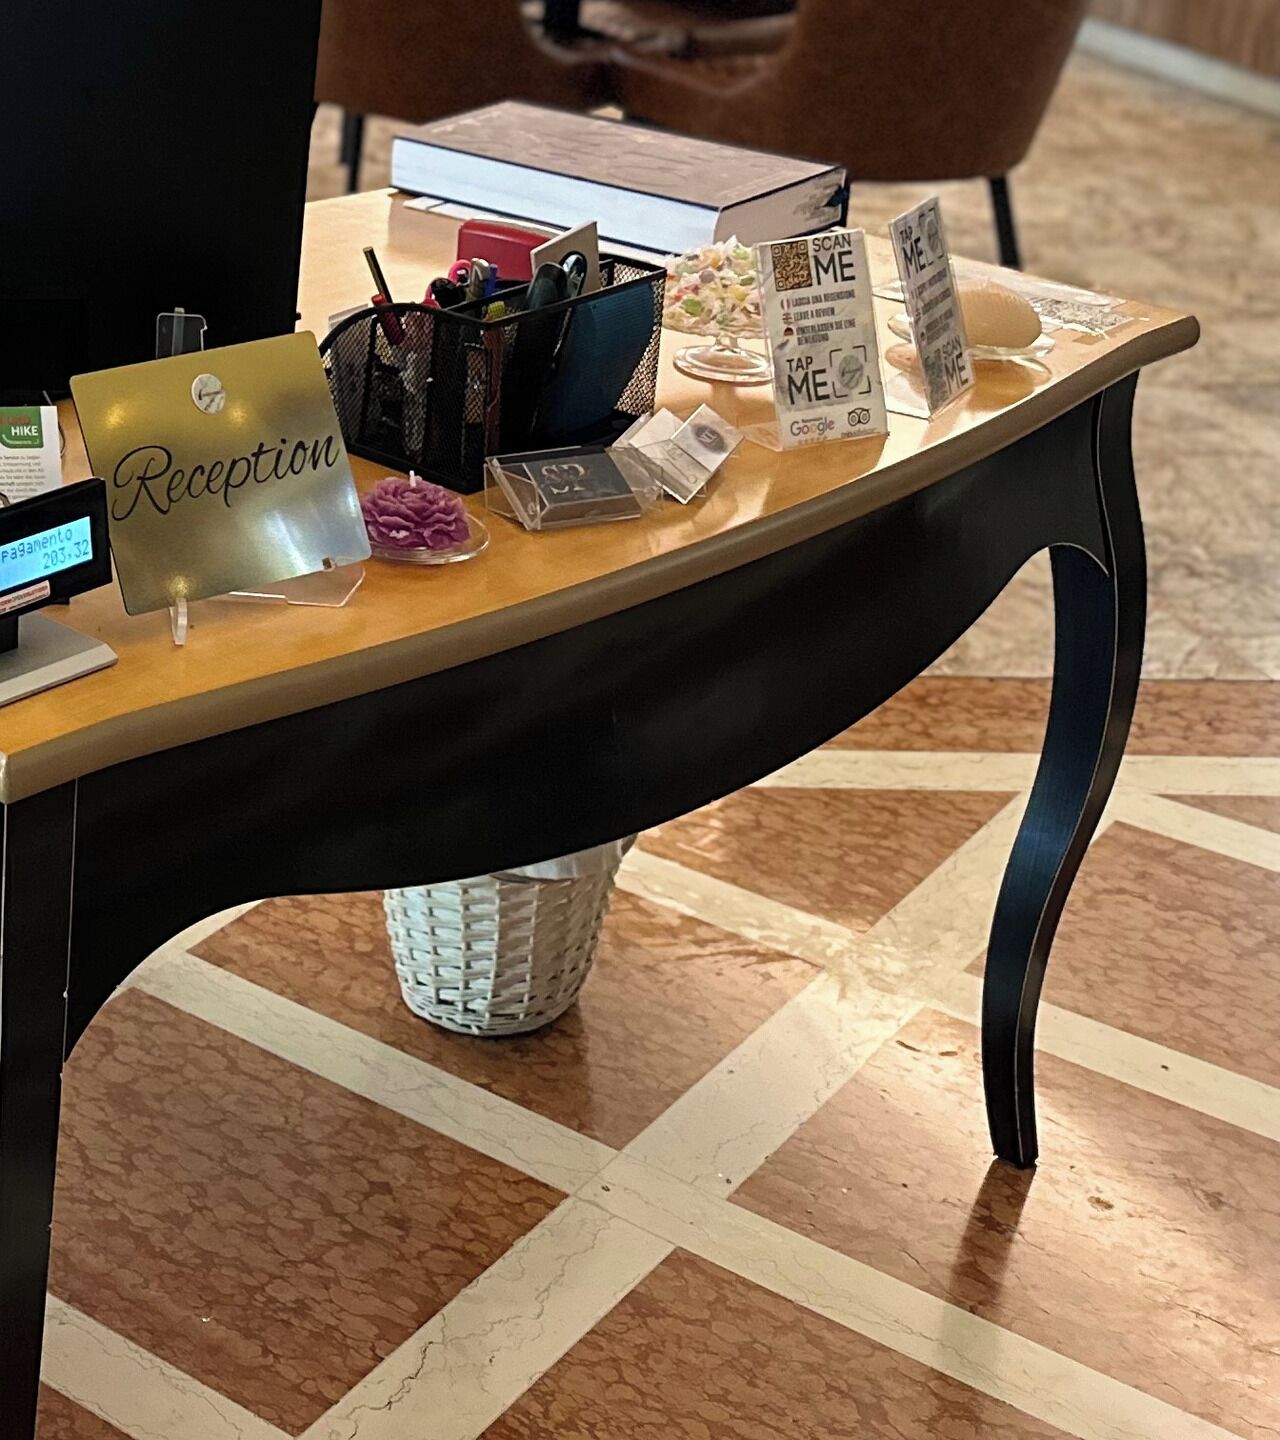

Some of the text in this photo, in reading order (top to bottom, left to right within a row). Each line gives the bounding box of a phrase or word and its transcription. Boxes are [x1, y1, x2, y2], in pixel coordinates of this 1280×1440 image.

[812, 233, 852, 253] SCAN
[899, 225, 913, 244] TAP
[813, 250, 856, 286] ME
[902, 236, 927, 279] ME
[941, 334, 963, 357] SCAN
[787, 355, 814, 373] TAP
[943, 352, 969, 395] ME
[787, 368, 831, 405] ME
[10, 425, 39, 437] HIKE
[790, 417, 835, 437] Google
[111, 435, 340, 522] Reception
